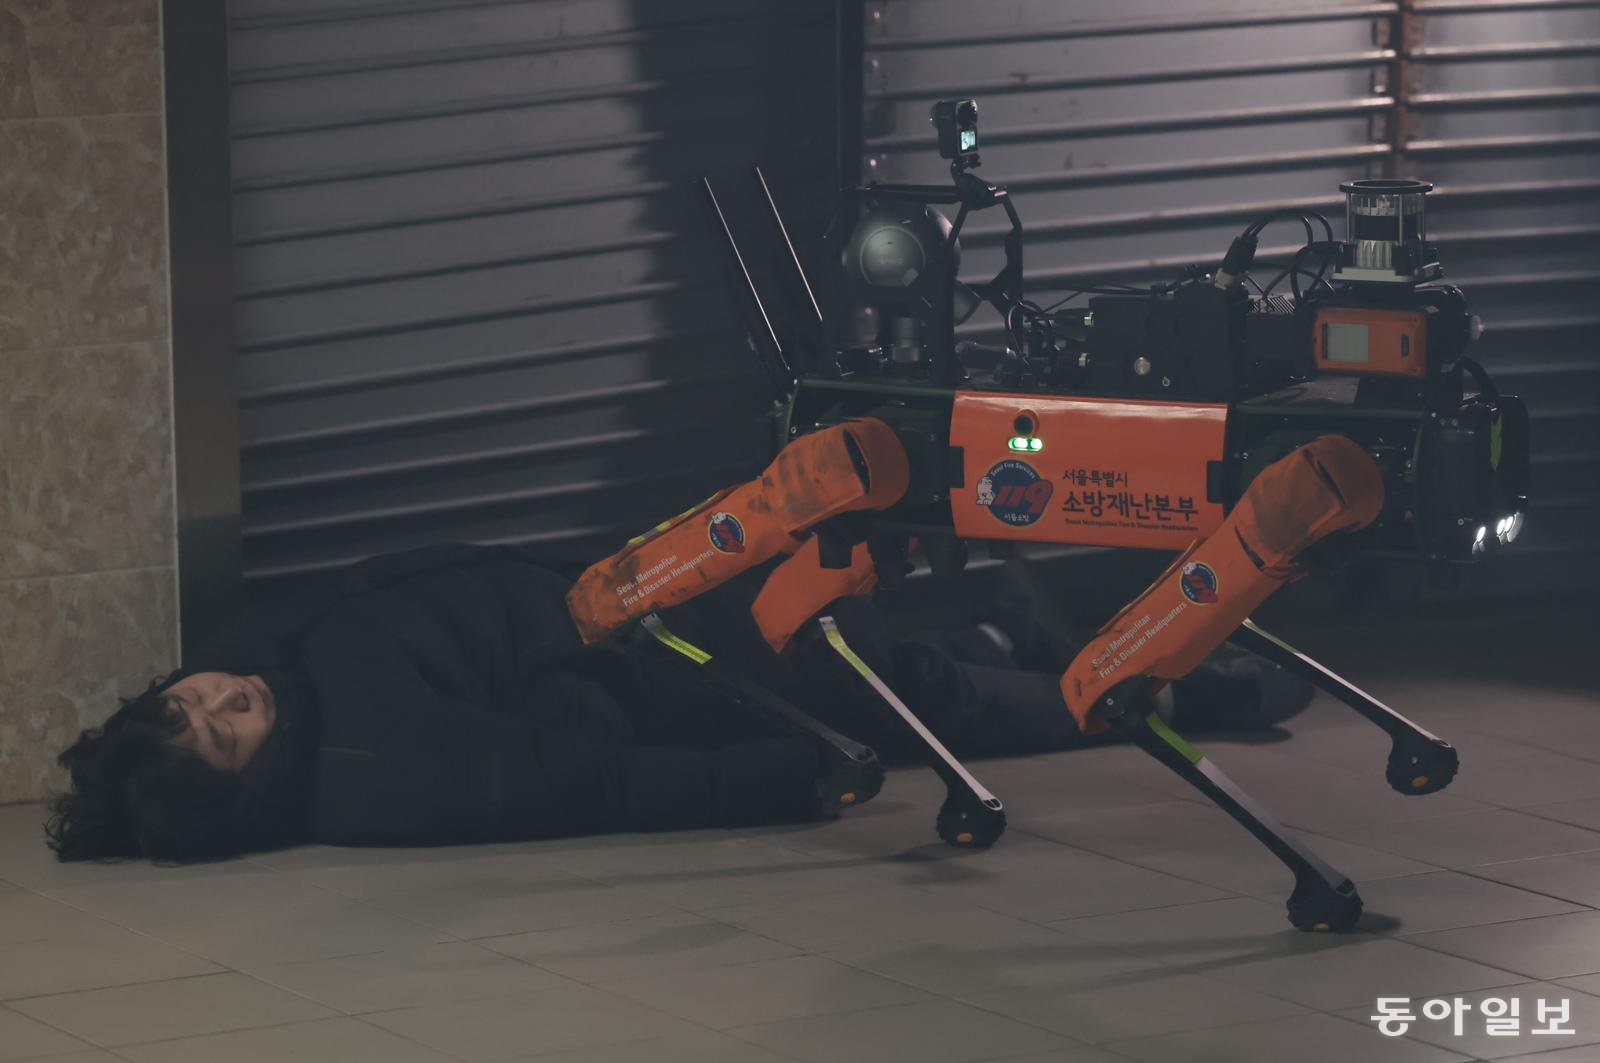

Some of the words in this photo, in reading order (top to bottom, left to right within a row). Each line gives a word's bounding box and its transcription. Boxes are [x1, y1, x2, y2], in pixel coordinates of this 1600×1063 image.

[1062, 469, 1128, 488] 서울특별시
[992, 479, 1054, 514] 119
[1062, 490, 1199, 522] 소방재난본부
[623, 594, 639, 607] Fire
[637, 588, 645, 598] &
[643, 574, 672, 595] Disaster
[671, 549, 715, 577] Headquarters
[636, 554, 677, 583] Metropolitan
[1092, 647, 1112, 668] Seoul
[1108, 615, 1152, 652] Metropolitan
[1099, 664, 1115, 678] Fire
[1113, 657, 1122, 668] &
[1119, 635, 1147, 661] Disaster
[1144, 601, 1187, 639] Headquarters
